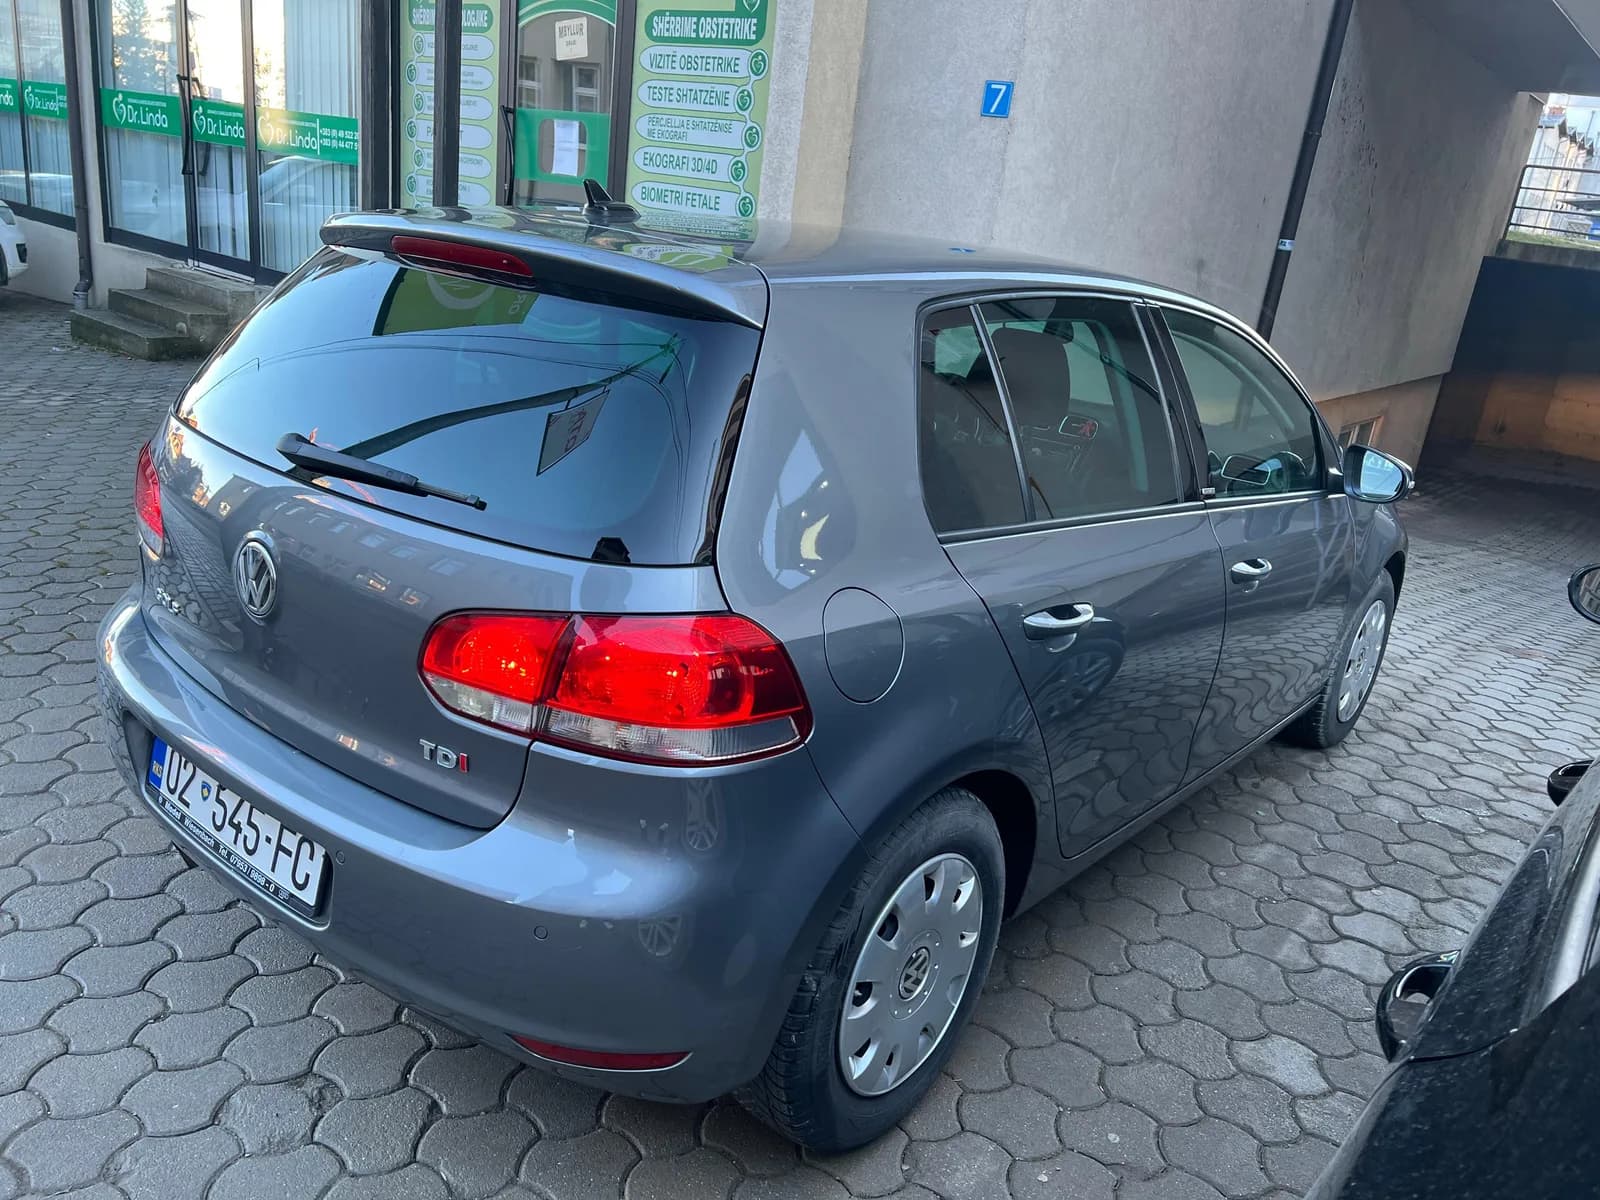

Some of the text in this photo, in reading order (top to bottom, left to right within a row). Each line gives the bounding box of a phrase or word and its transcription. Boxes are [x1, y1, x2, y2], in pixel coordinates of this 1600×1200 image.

[652, 11, 758, 40] SHËRBIME OBSTETRIKE
[649, 51, 741, 73] VIZITË OBSTETRIKE
[647, 86, 674, 102] TESTE
[990, 83, 1007, 113] 7
[127, 105, 168, 128] Dr.Linda
[207, 118, 245, 139] Dr.Linda
[657, 129, 688, 141] EKOGRAFI
[643, 151, 718, 175] EKOGRAFI 3D/4D
[640, 185, 721, 212] BIOMETRI FETALE
[419, 738, 468, 774] TDI
[167, 749, 315, 892] 02 545-FC
[218, 844, 229, 859] Tel.
